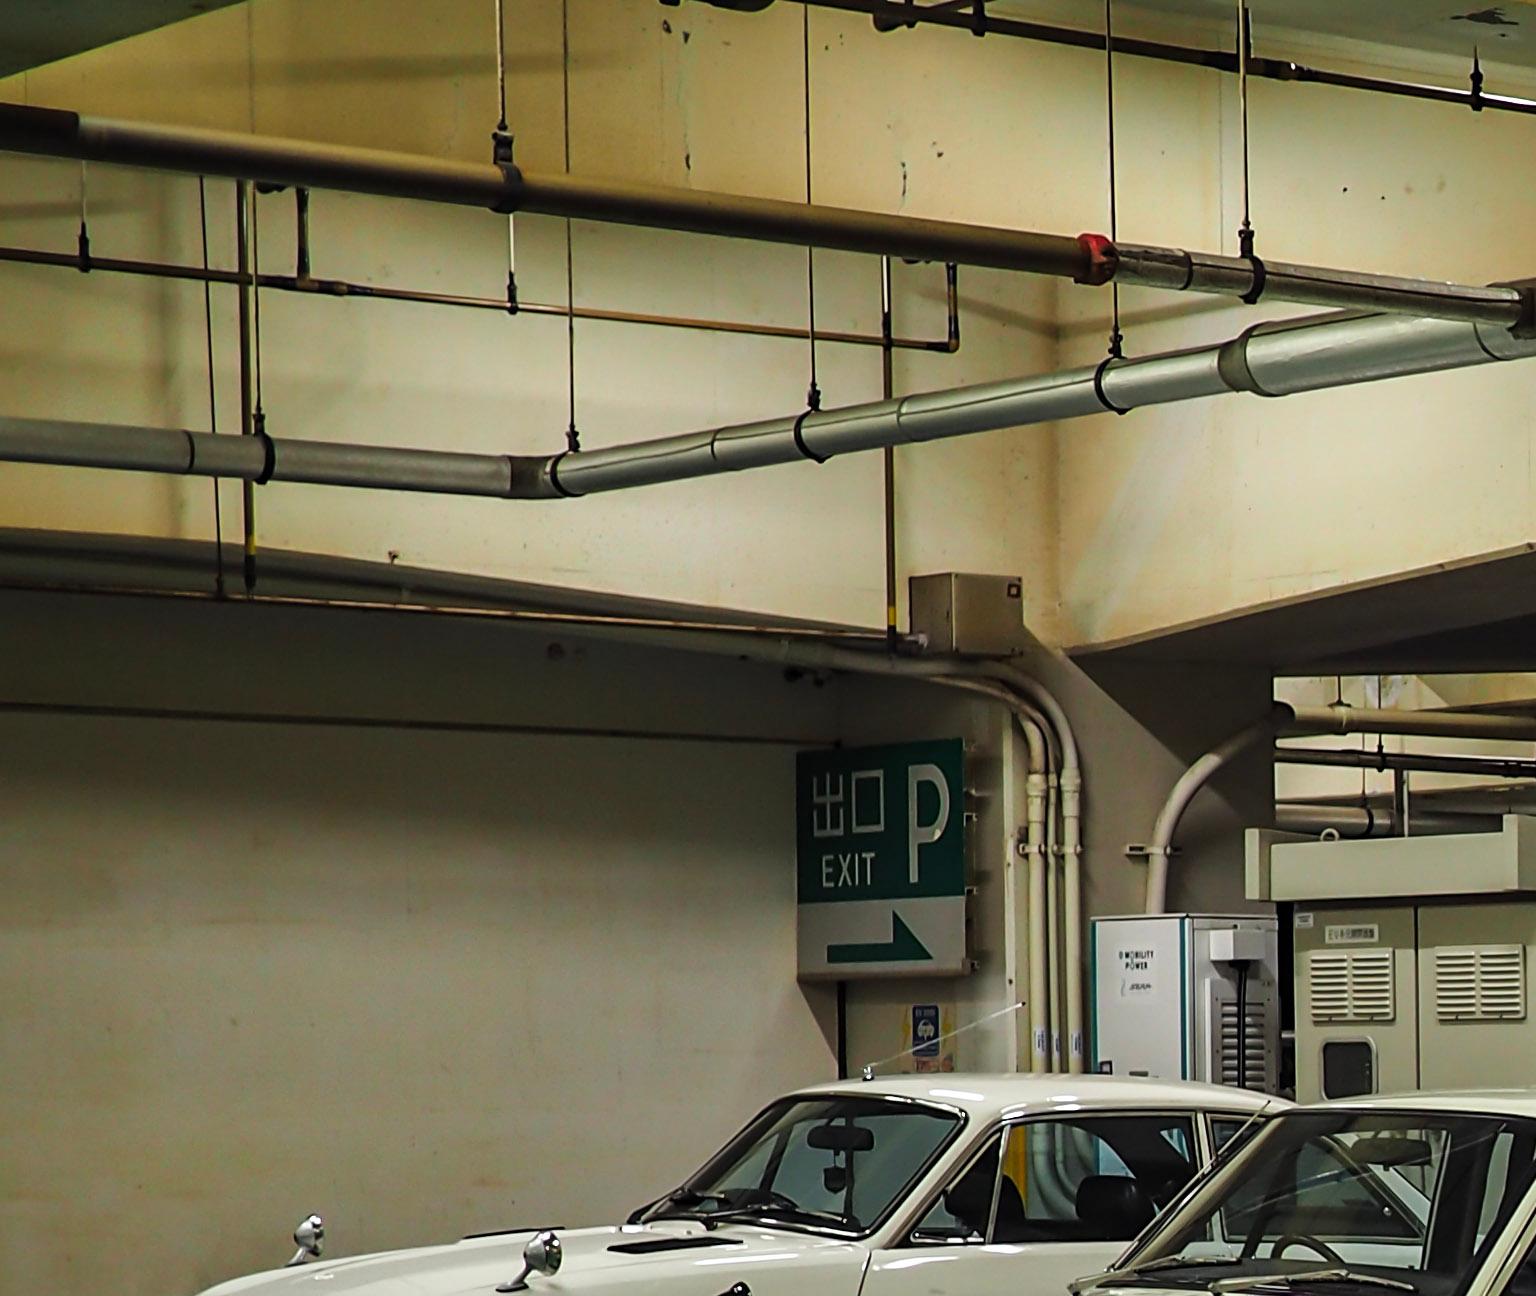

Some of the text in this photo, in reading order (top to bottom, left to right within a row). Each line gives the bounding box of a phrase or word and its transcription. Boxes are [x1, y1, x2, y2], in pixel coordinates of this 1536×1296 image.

[813, 769, 885, 837] 出口
[908, 763, 950, 884] P
[822, 852, 876, 888] EXIT
